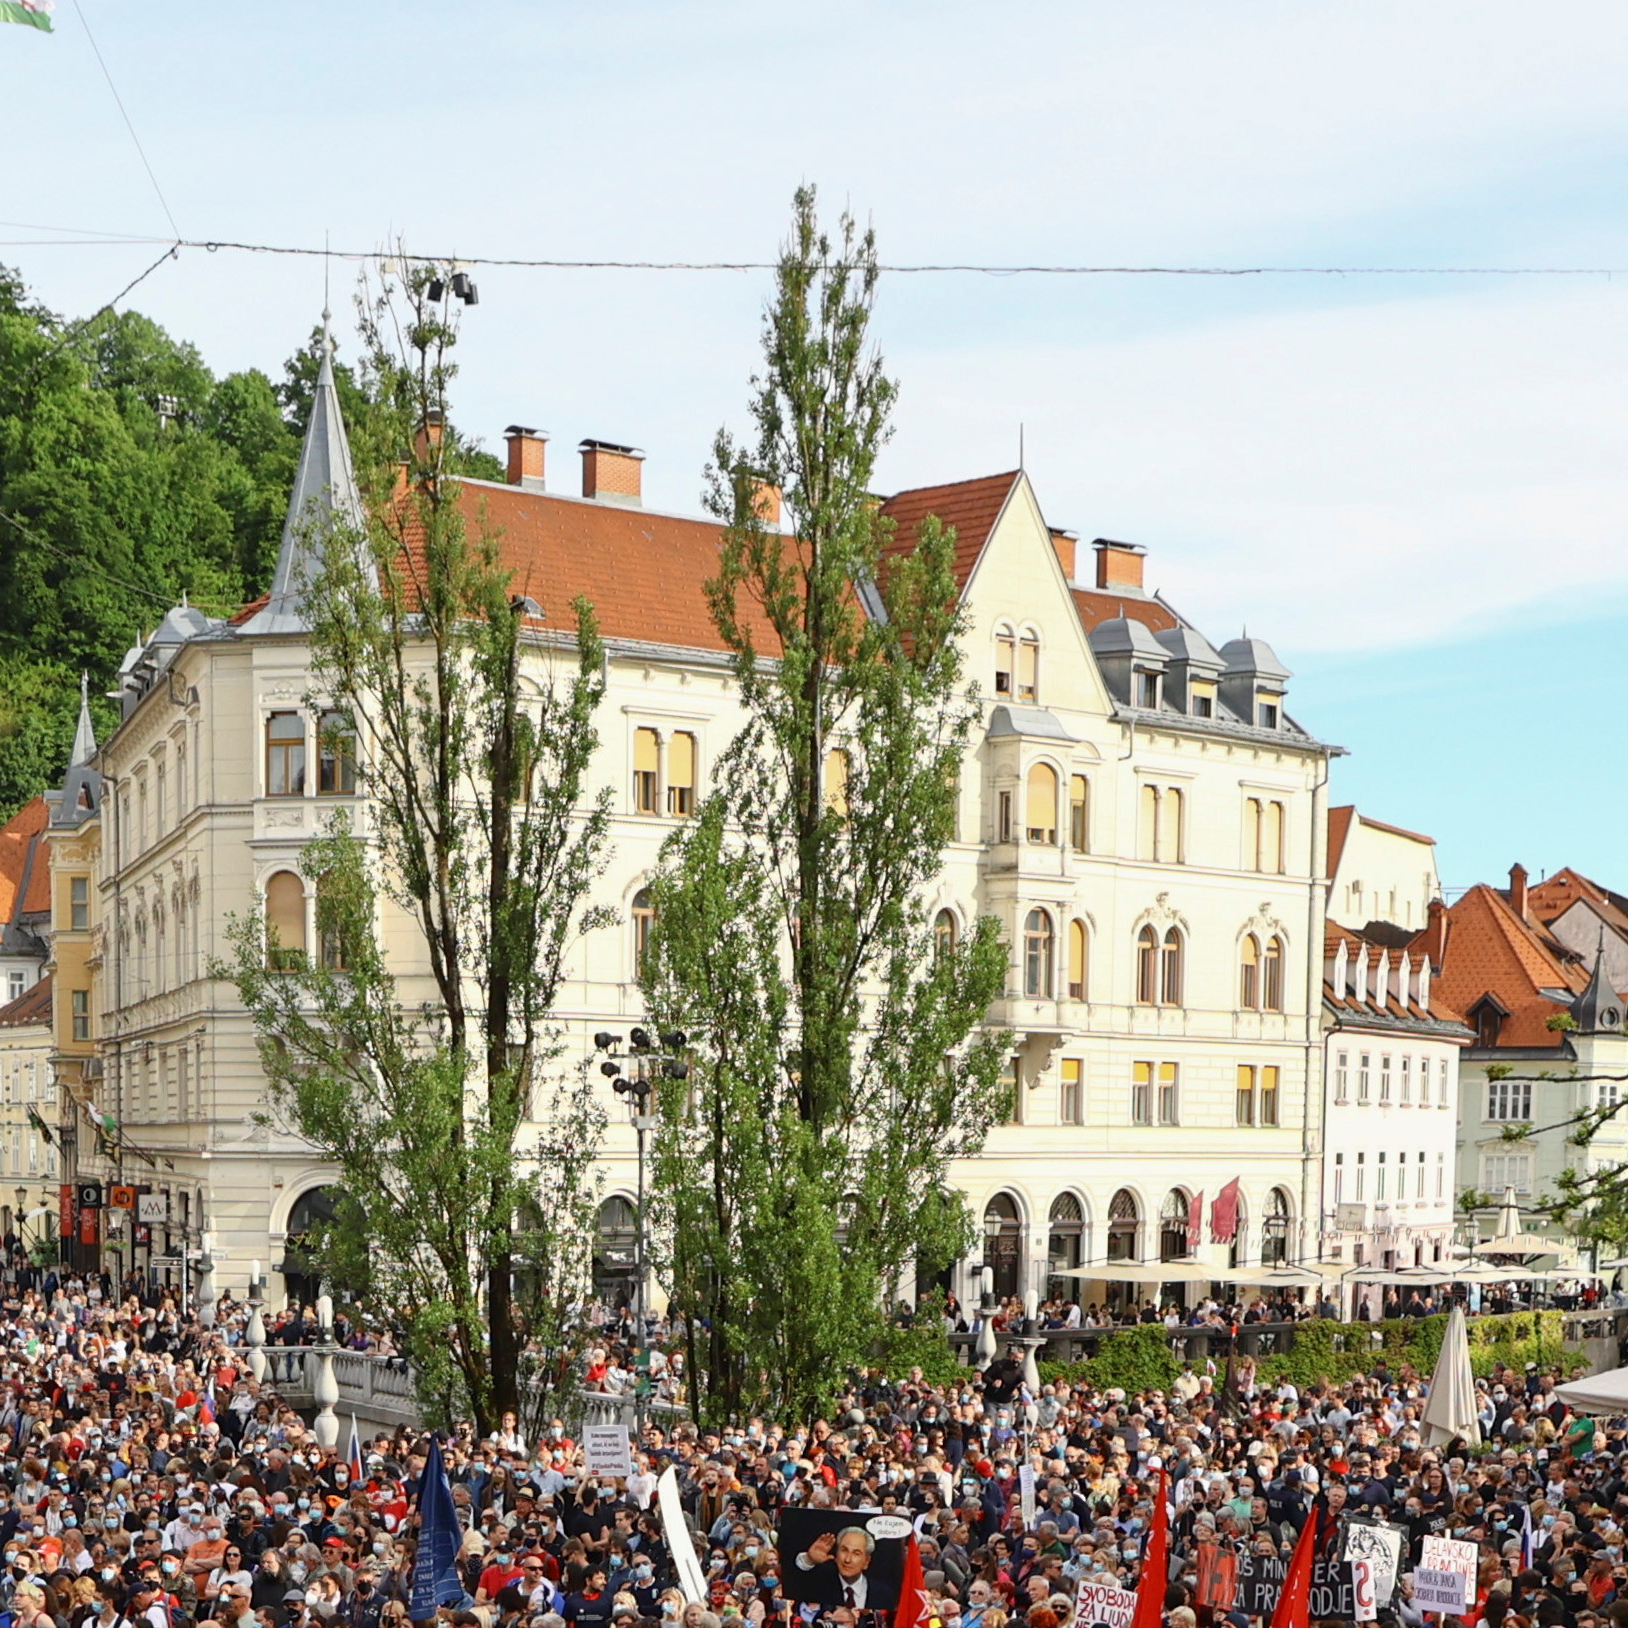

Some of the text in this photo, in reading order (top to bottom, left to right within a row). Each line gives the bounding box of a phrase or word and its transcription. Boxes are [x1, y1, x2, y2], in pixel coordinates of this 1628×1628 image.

[1424, 1536, 1473, 1561] DELAVSKO
[1263, 1558, 1340, 1583] MINER
[1078, 1585, 1135, 1610] SVOBODA
[1255, 1583, 1353, 1616] PRAODJE
[1077, 1602, 1096, 1620] ZA
